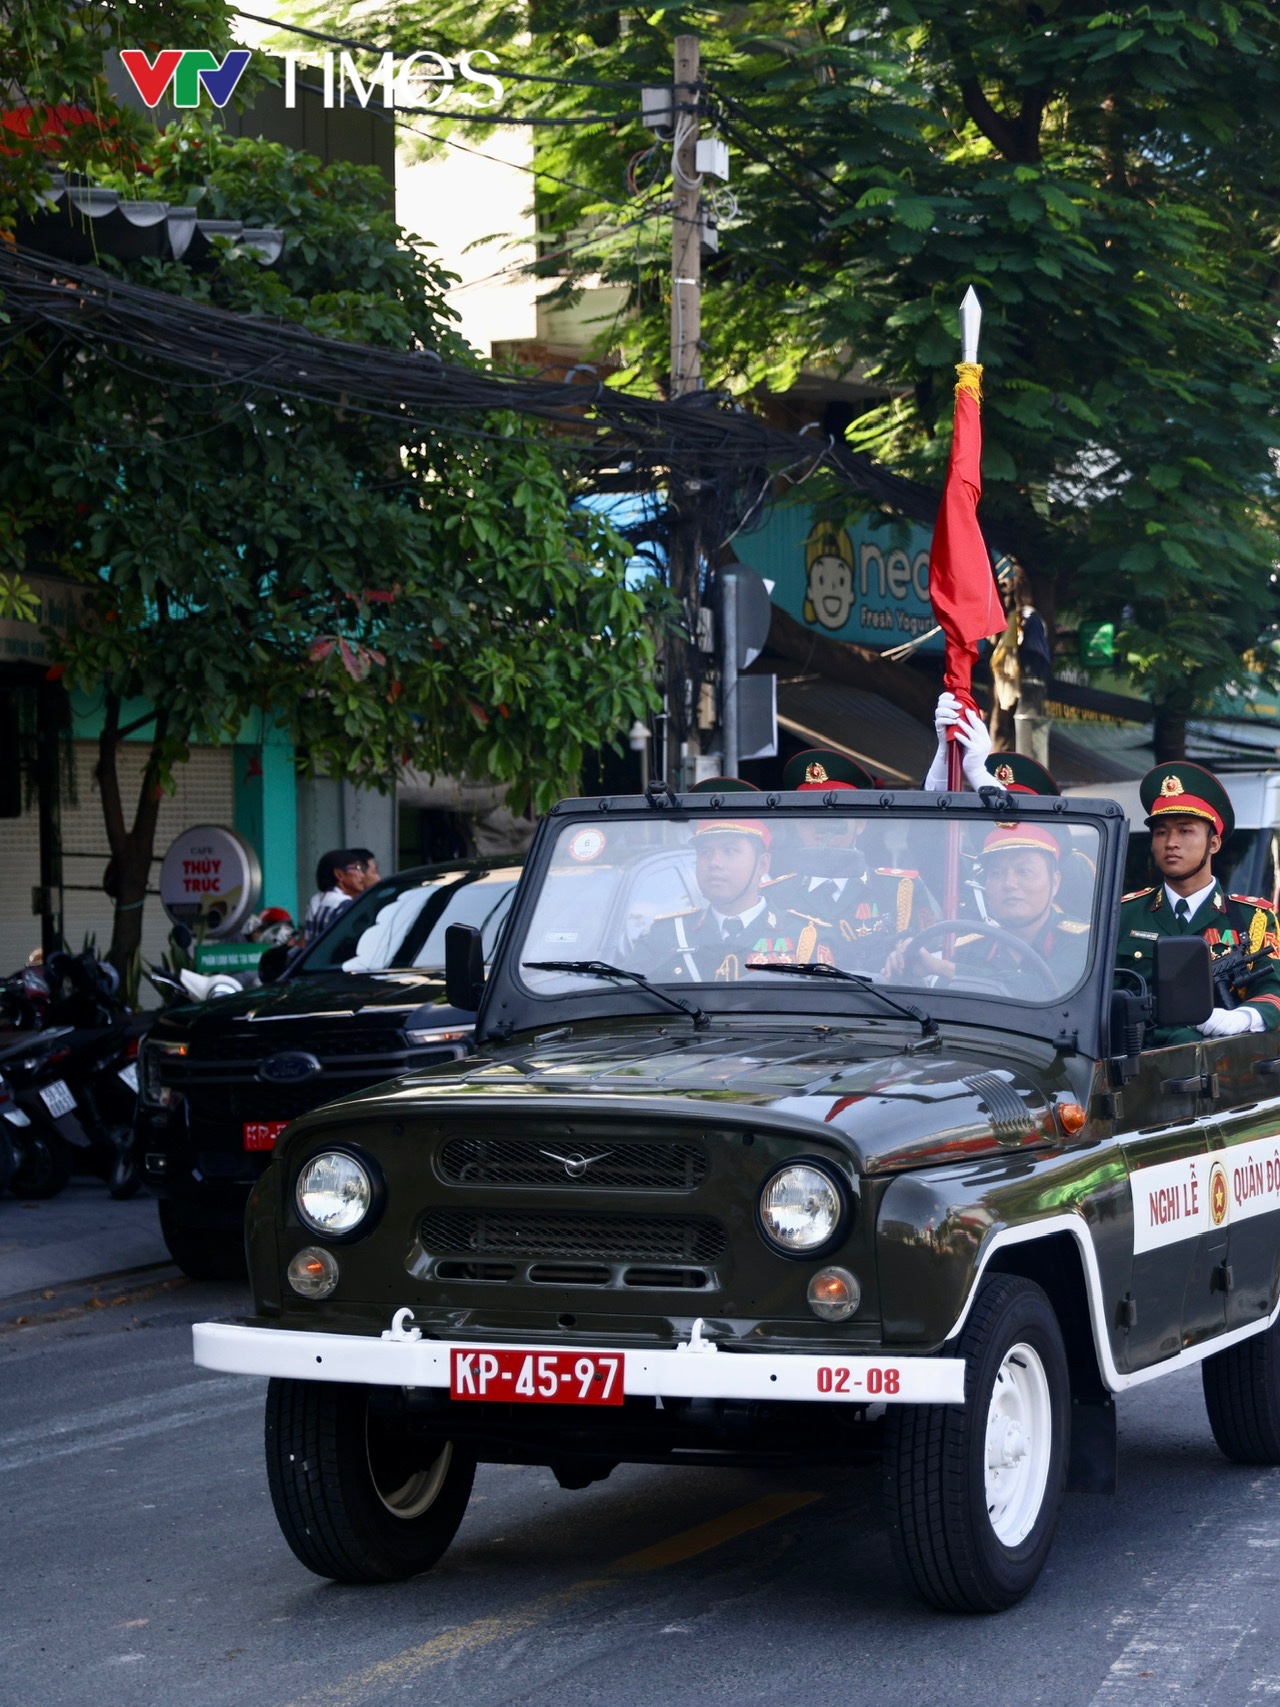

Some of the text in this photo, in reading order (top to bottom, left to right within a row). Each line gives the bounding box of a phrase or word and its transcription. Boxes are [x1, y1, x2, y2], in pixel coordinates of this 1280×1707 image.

[861, 605, 893, 630] Fresh
[1149, 1185, 1180, 1227] NGHI
[1183, 1163, 1199, 1217] LỄ
[1233, 1156, 1264, 1207] QUÂN
[456, 1352, 619, 1399] KP-45-97
[816, 1366, 901, 1395] 02-08
